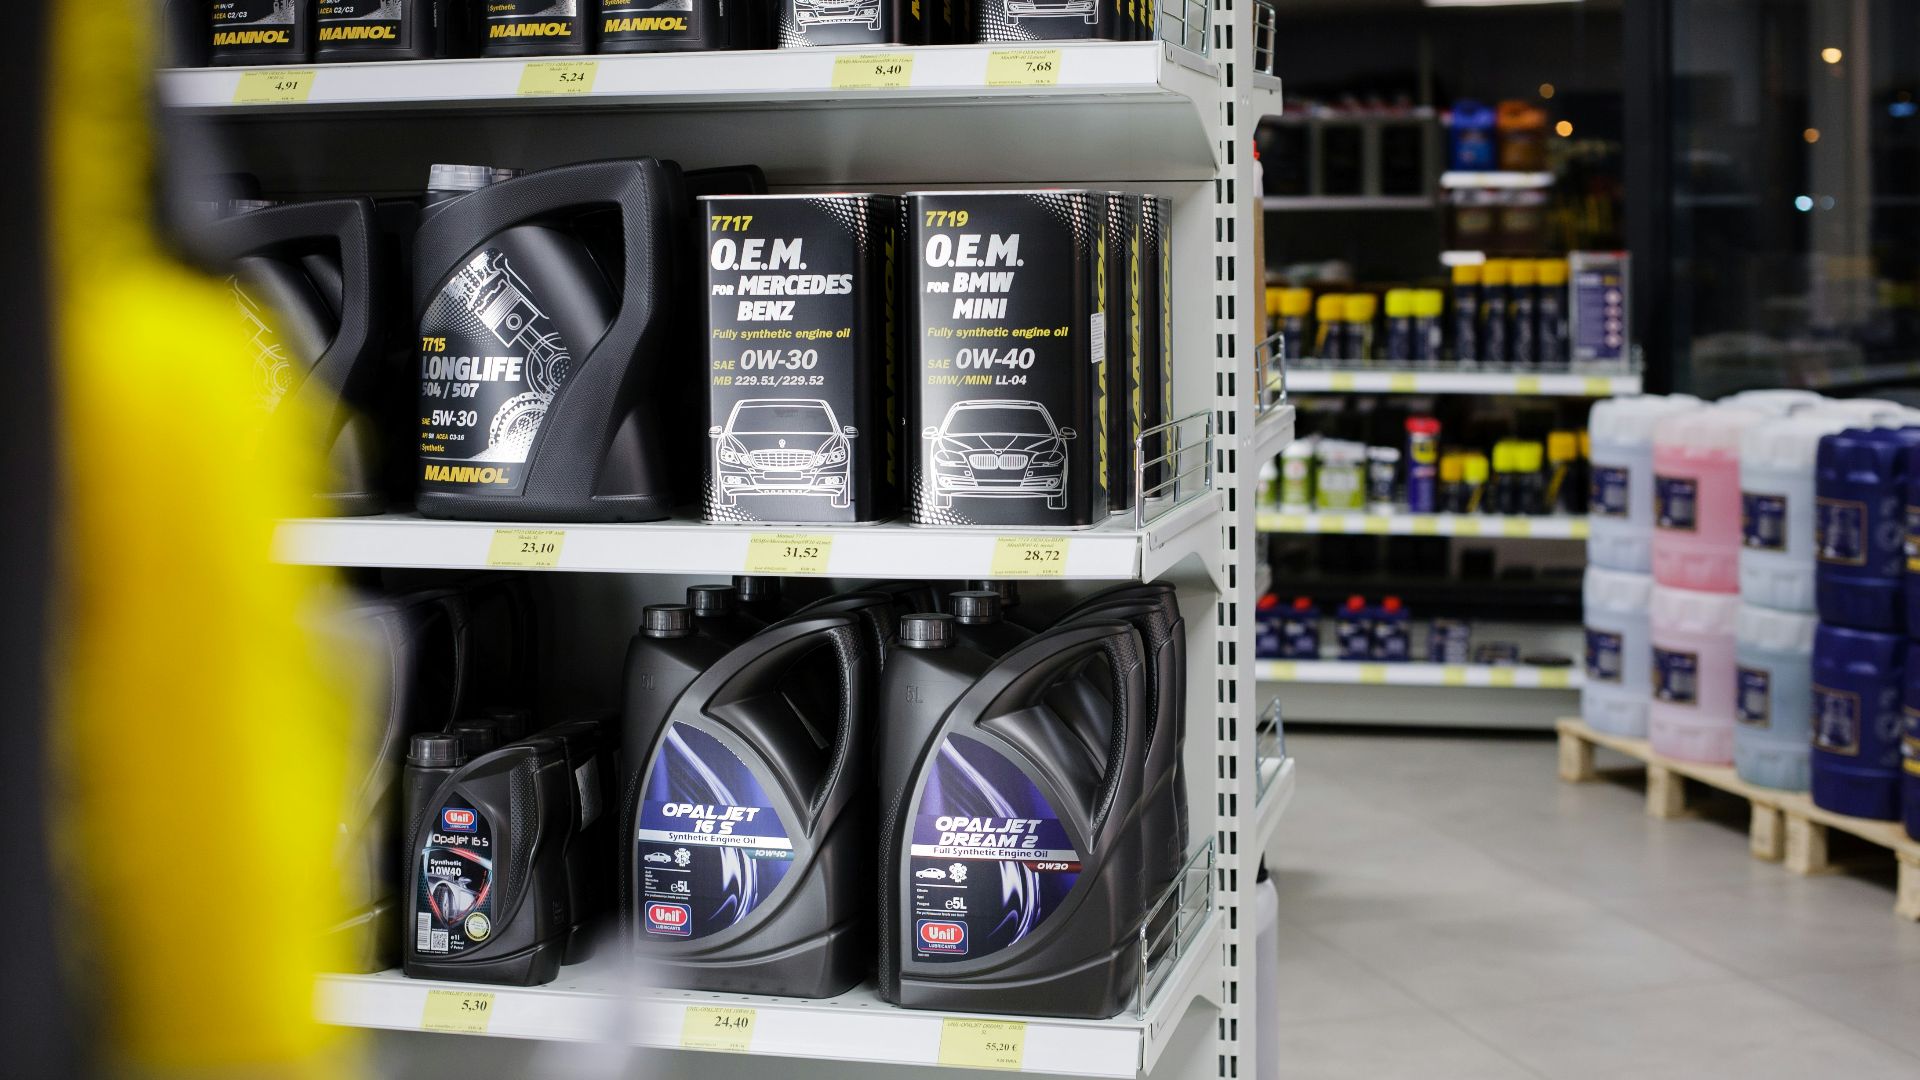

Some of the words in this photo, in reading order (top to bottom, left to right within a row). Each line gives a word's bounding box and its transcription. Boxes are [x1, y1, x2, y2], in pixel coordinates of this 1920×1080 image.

[227, 11, 248, 19] C2/C3
[333, 6, 354, 15] C2/C3
[489, 4, 516, 12] Synthetic
[319, 25, 396, 40] MANNOL
[489, 23, 572, 38] MANNOL
[604, 17, 688, 33] MANNOL
[213, 30, 290, 46] MANNOL
[875, 65, 902, 76] 8,40
[1025, 62, 1052, 72] 7,68
[711, 215, 753, 232] 7717
[925, 210, 969, 228] 7719
[710, 238, 807, 271] O.E.M.
[925, 233, 1024, 267] O.E.M.
[712, 284, 735, 296] FOR
[737, 274, 853, 296] MERCEDES
[927, 282, 949, 293] FOR
[952, 271, 1015, 293] BMW
[737, 301, 796, 322] BENZ
[952, 298, 1008, 319] MINI
[713, 329, 738, 341] Fully
[740, 328, 792, 341] synthetic
[795, 329, 833, 341] engine
[836, 328, 851, 338] oil
[927, 327, 953, 340] Fully
[956, 327, 1009, 340] synthetic
[1012, 327, 1051, 340] engine
[1054, 327, 1069, 337] oil
[422, 337, 446, 352] 7715
[713, 360, 735, 370] SAE
[740, 349, 818, 370] 0W-30
[927, 359, 951, 369] SAE
[955, 348, 1035, 370] 0W-40
[422, 356, 524, 382] LONGLIFE
[713, 376, 732, 386] MB
[734, 375, 824, 388] 229.51/229.52
[927, 375, 993, 388] BMW/MINI
[995, 375, 1028, 386] LL-04
[422, 382, 442, 396] 504
[452, 383, 479, 398] 507
[422, 417, 431, 425] SAE
[432, 410, 478, 427] 5W-30
[421, 443, 445, 452] Synthetic
[424, 465, 509, 484] MANNOL
[1024, 550, 1060, 563] 28,72
[450, 813, 469, 823] Unil
[662, 802, 760, 822] OPALJET
[693, 820, 716, 834] 16
[718, 821, 736, 835] S
[935, 816, 1043, 834] OPALJET
[432, 833, 469, 846] Opaljet
[471, 837, 481, 846] 16
[481, 837, 489, 847] S
[668, 832, 708, 842] Synthetic
[711, 834, 741, 845] Engine
[743, 836, 756, 845] Oil
[939, 832, 1018, 848] DREAM
[1021, 836, 1039, 849] 2
[754, 850, 787, 858] 10W40
[933, 846, 951, 855] Full
[953, 847, 996, 858] Synthetic
[999, 849, 1033, 859] Engine
[1035, 850, 1048, 858] Oil
[430, 858, 462, 867] Synthetic
[430, 866, 462, 877] 10W40
[655, 908, 680, 923] Unil
[928, 926, 954, 941] Unil
[714, 1015, 749, 1029] 24,40
